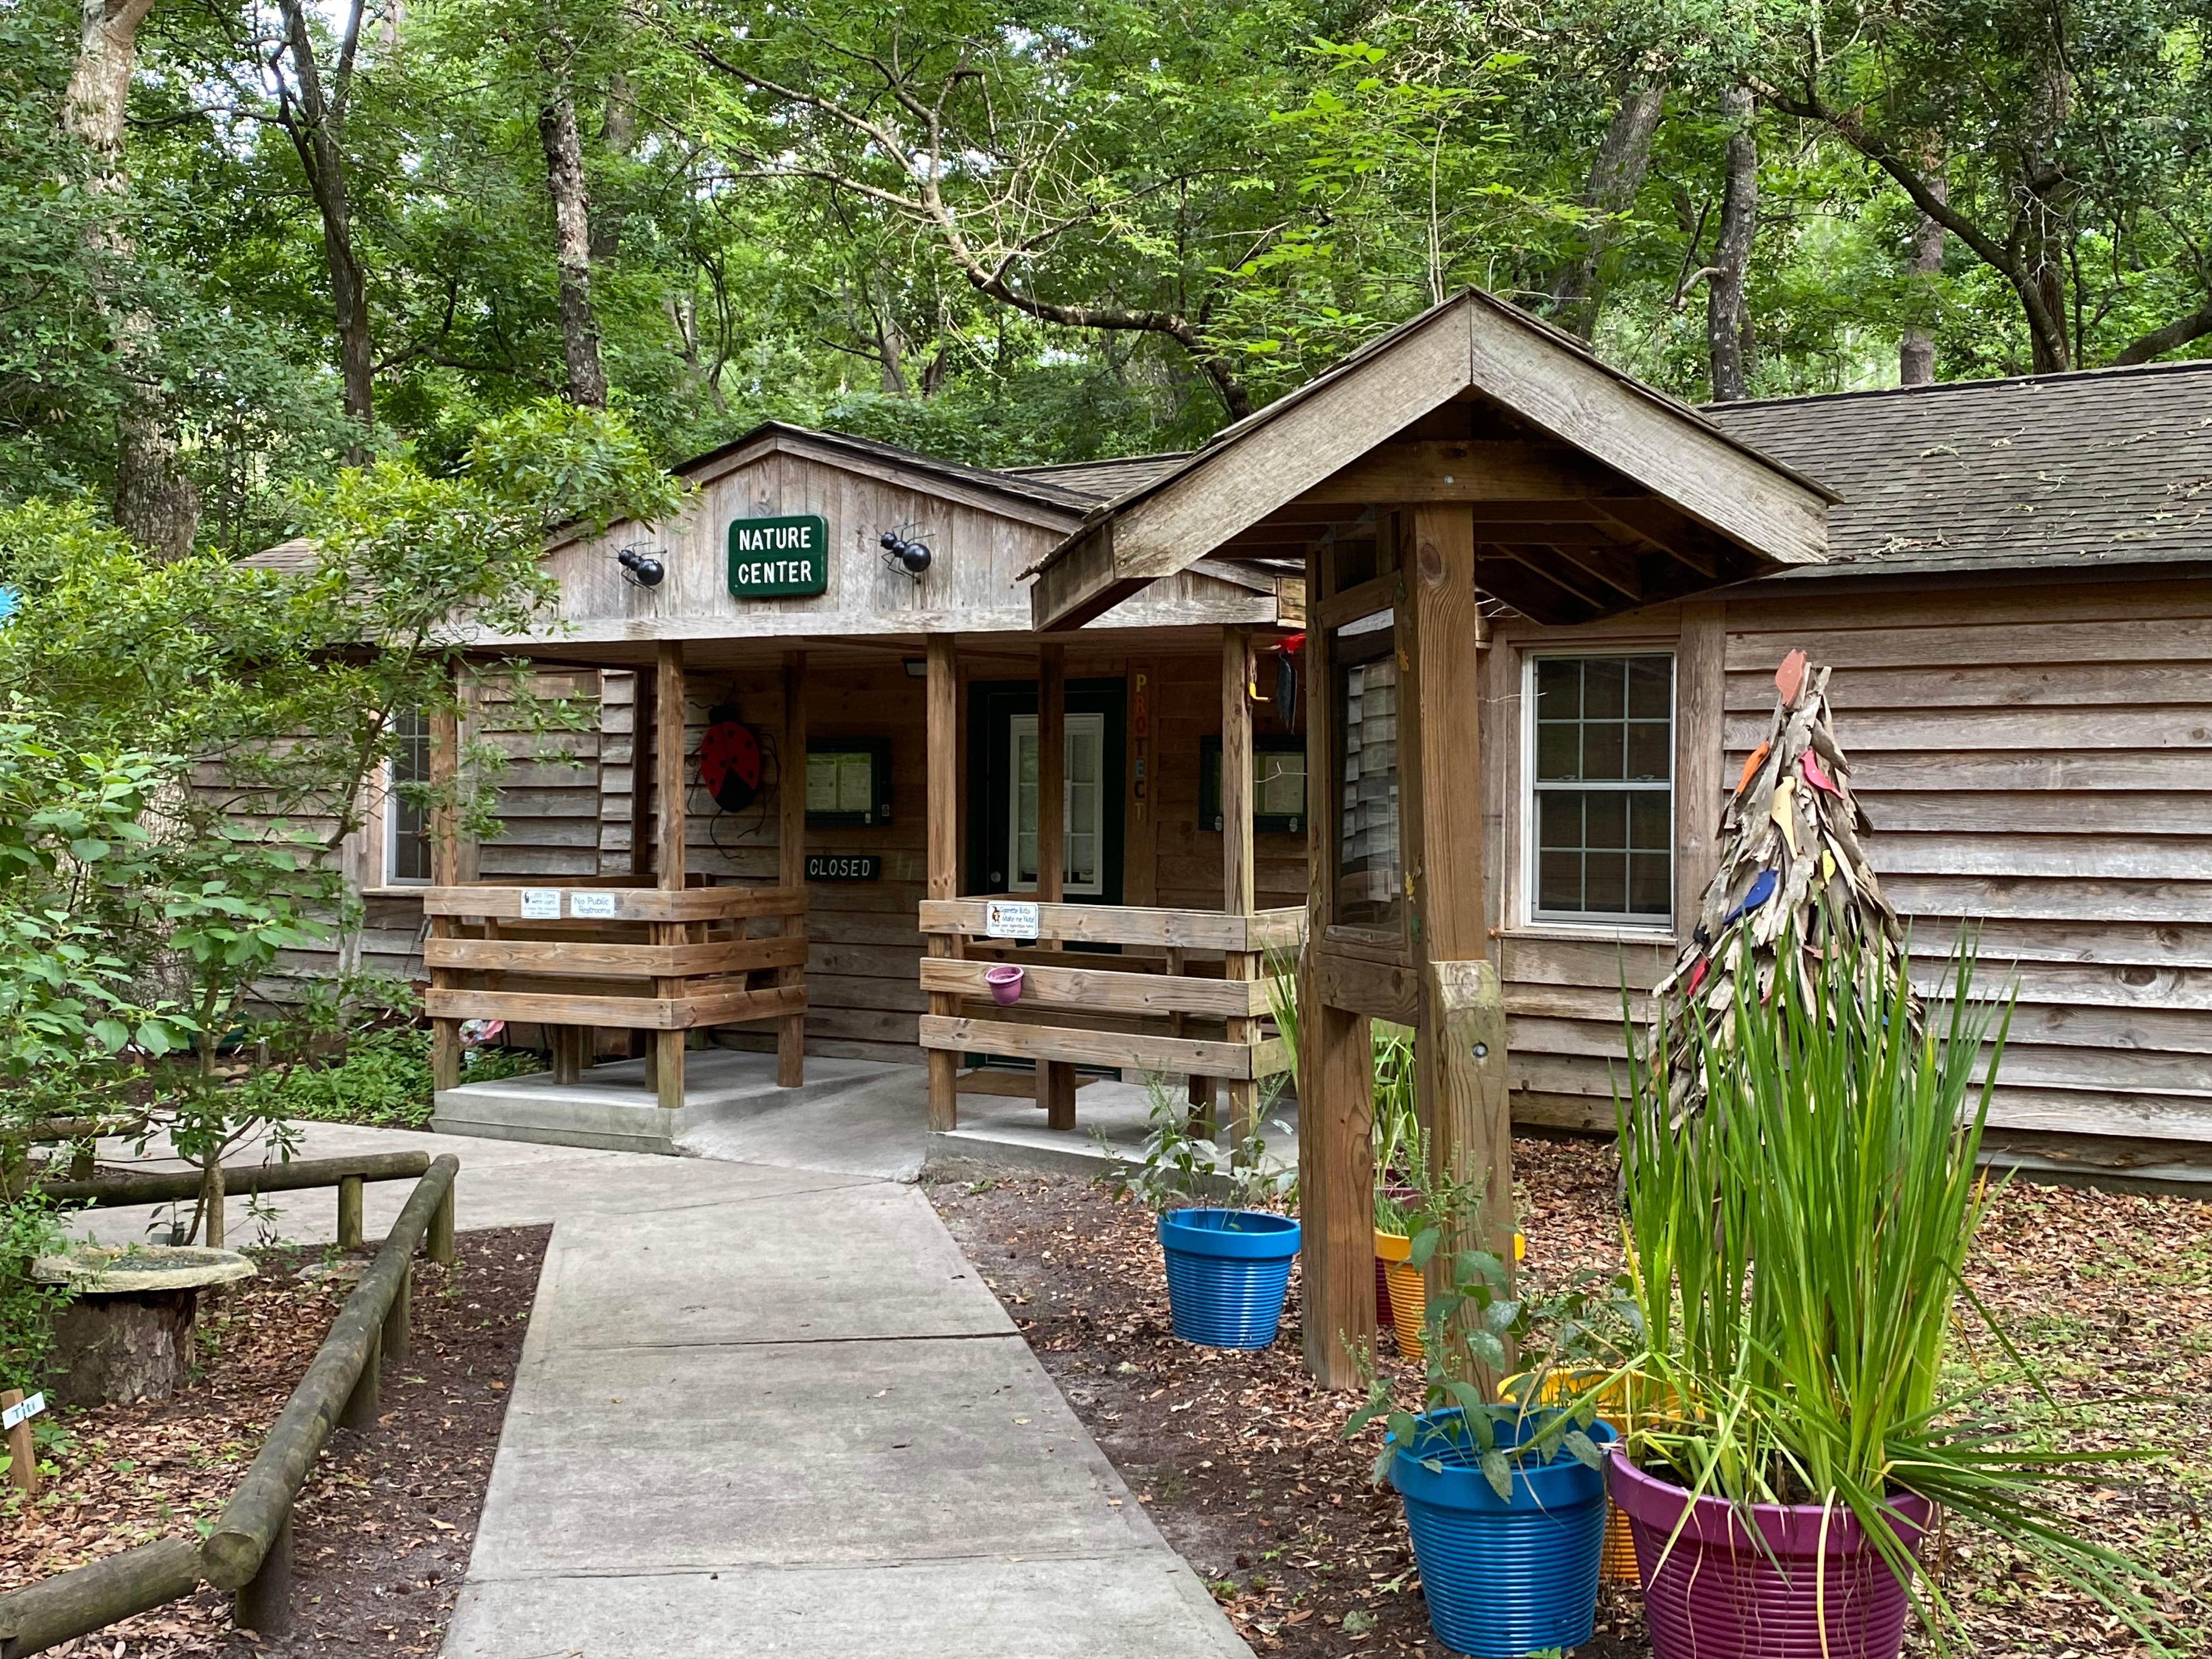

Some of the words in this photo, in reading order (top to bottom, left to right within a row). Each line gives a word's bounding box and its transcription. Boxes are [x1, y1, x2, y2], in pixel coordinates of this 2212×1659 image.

[740, 526, 811, 551] NATURE
[738, 560, 812, 584] CENTER
[1134, 674, 1147, 820] PROTECT
[810, 859, 870, 876] CLOSED
[579, 905, 611, 915] Restrooms
[588, 896, 610, 905] Public
